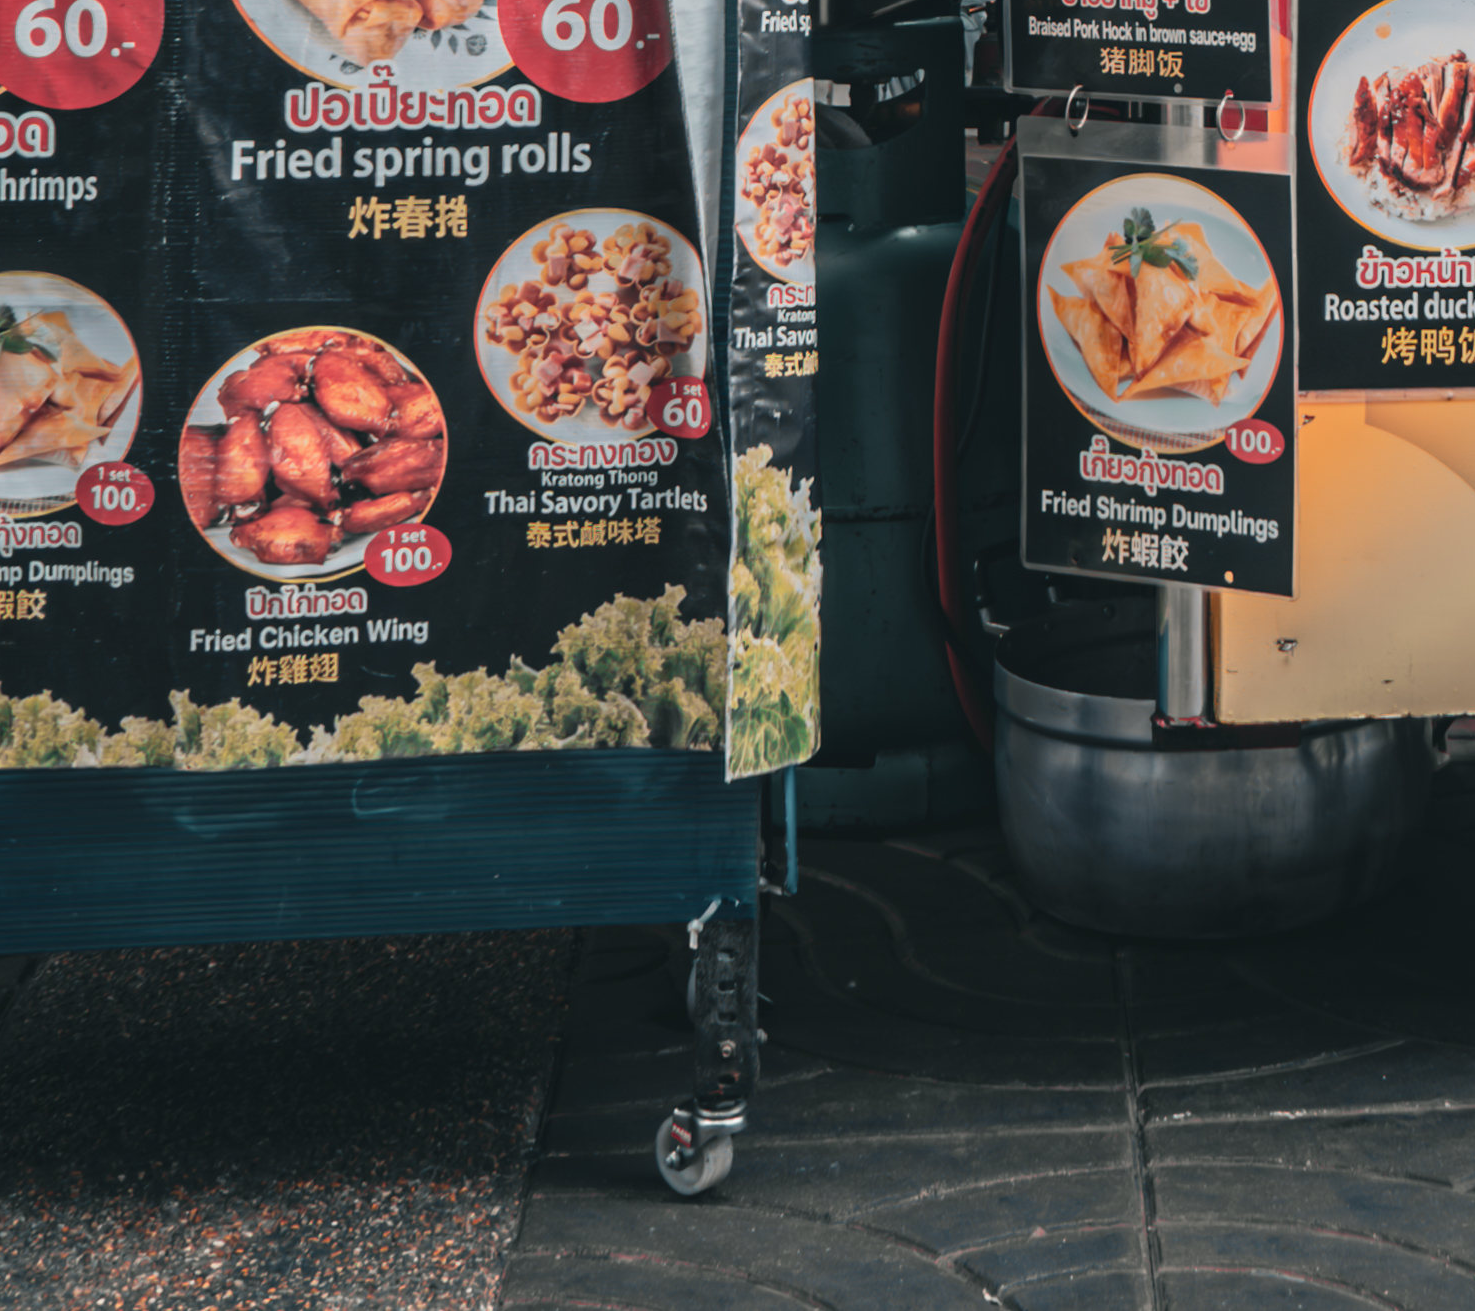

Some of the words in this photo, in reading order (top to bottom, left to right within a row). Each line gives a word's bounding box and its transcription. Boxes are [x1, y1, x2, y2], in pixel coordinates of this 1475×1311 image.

[285, 64, 543, 132] ปอเปี๊ยะทอด
[231, 137, 342, 181] Fried
[353, 137, 489, 187] spring
[502, 132, 591, 173] rolls
[1325, 291, 1418, 321] Roasted
[542, 470, 606, 489] Kratong
[608, 468, 658, 486] Thong
[484, 490, 535, 514] Thai
[541, 489, 623, 518] Savory
[627, 486, 707, 512] Tartlets
[29, 561, 134, 588] Dumplings
[190, 627, 252, 651] Fried
[259, 624, 359, 649] Chicken
[367, 618, 428, 644] Wing
[248, 653, 339, 686] 炸雞翅
